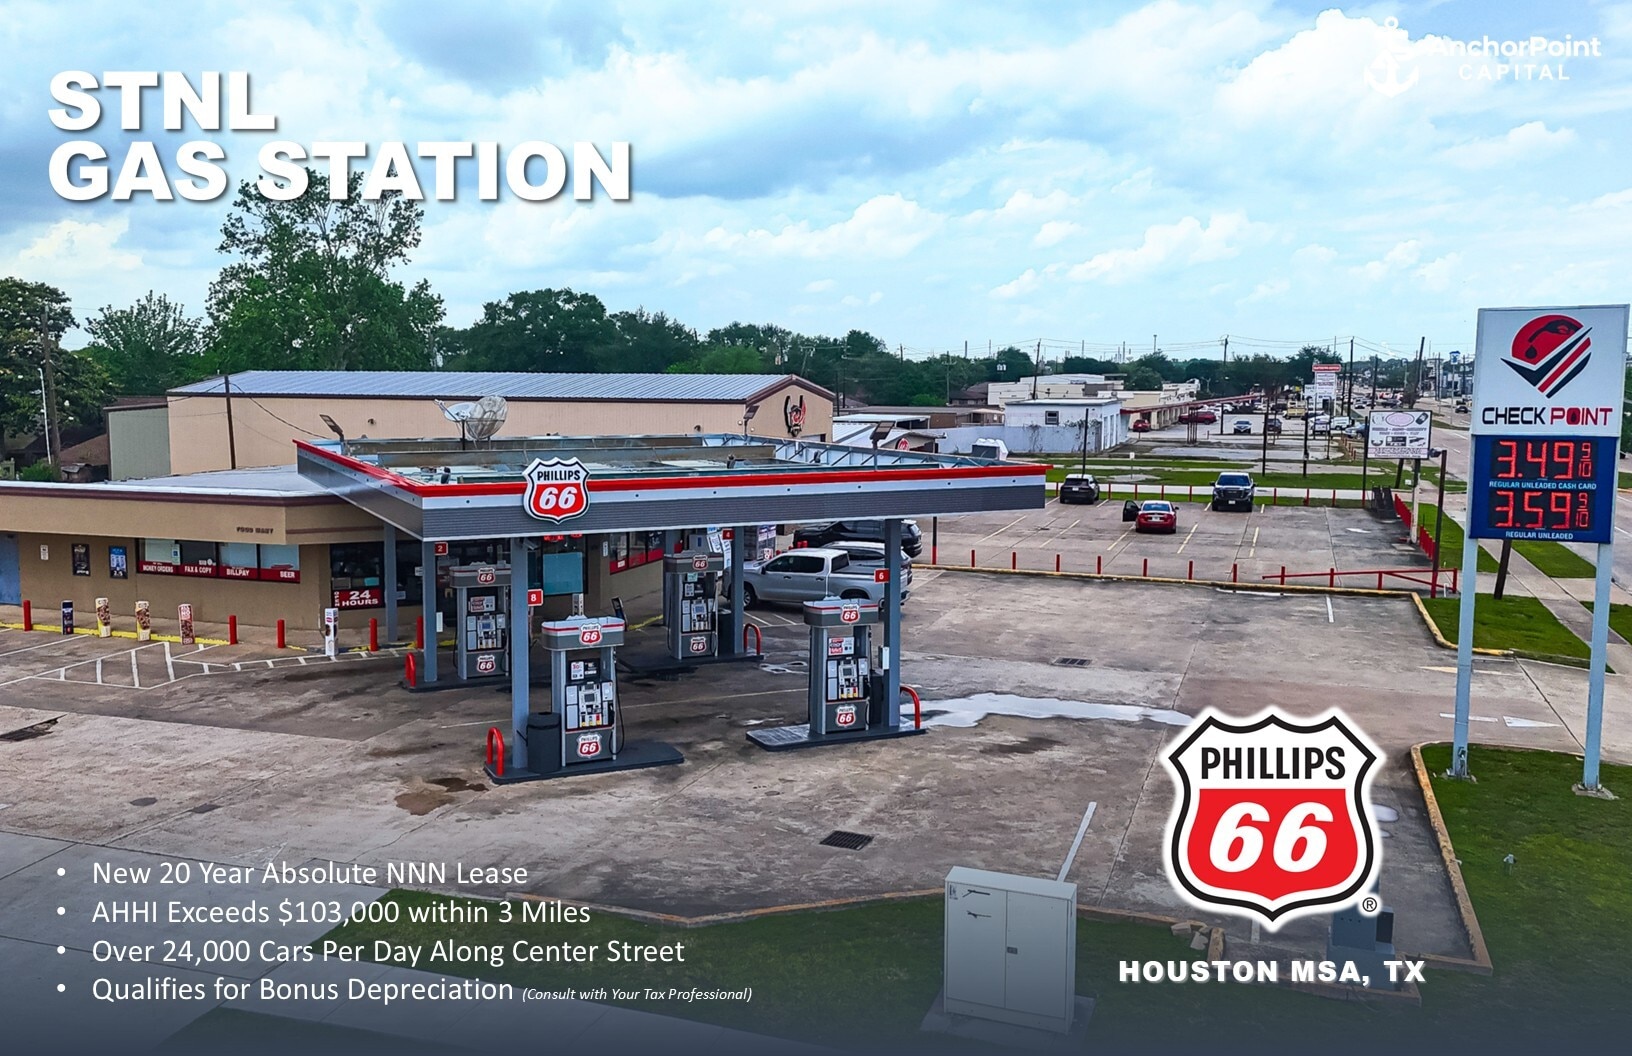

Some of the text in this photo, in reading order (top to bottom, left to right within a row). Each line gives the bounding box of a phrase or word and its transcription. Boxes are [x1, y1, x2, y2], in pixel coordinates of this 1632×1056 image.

[1482, 407, 1613, 426] CHECK POINT
[1497, 441, 1575, 479] 3.49
[537, 470, 580, 481] PHILLIPS
[1489, 480, 1520, 488] REGULAR
[1521, 481, 1557, 489] UNLEADED
[1559, 482, 1577, 490] CASH
[539, 486, 578, 510] 66
[1495, 491, 1571, 529] 3.59
[1505, 531, 1573, 540] REGULAR UNLEADED
[142, 564, 174, 573] MONEY ORDERS
[694, 560, 706, 568] 66
[184, 565, 194, 573] FAX
[199, 566, 212, 574] COPY
[226, 568, 250, 577] BILLPAY
[349, 589, 371, 600] 24
[341, 598, 379, 607] HOURS
[843, 611, 857, 620] 66
[583, 632, 598, 641] 66
[480, 662, 493, 670] 66
[839, 714, 853, 723] 66
[582, 743, 597, 753] 66
